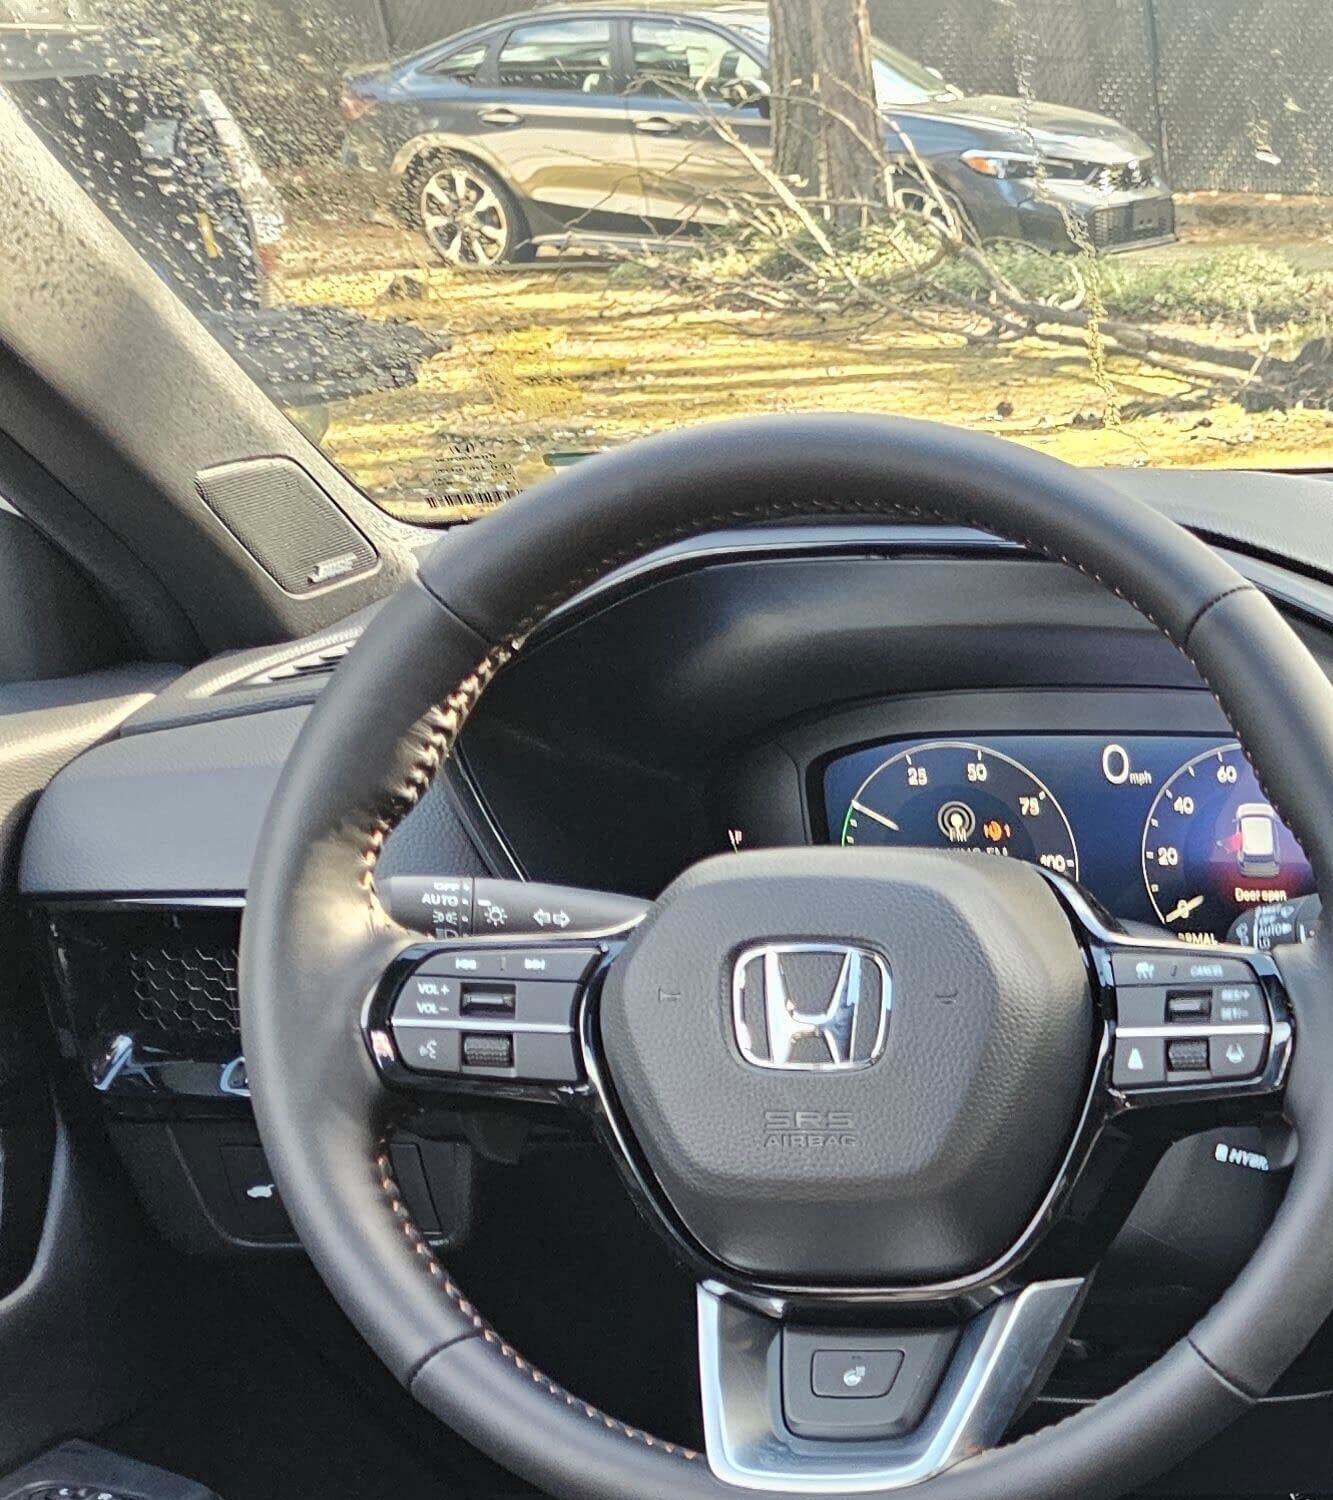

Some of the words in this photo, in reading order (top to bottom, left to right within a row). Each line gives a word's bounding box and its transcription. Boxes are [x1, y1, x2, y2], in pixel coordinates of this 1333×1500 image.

[967, 763, 987, 782] 50
[1102, 744, 1129, 784] 0
[1129, 771, 1152, 785] mph
[907, 767, 927, 786] 25
[1217, 765, 1237, 784] 60
[1019, 797, 1040, 816] 75
[1174, 796, 1194, 814] 40
[1158, 847, 1178, 865] 20
[421, 893, 459, 906] AUTO
[1235, 887, 1260, 902] Door
[763, 1110, 856, 1129] SRS
[763, 1133, 857, 1148] AIRBAG
